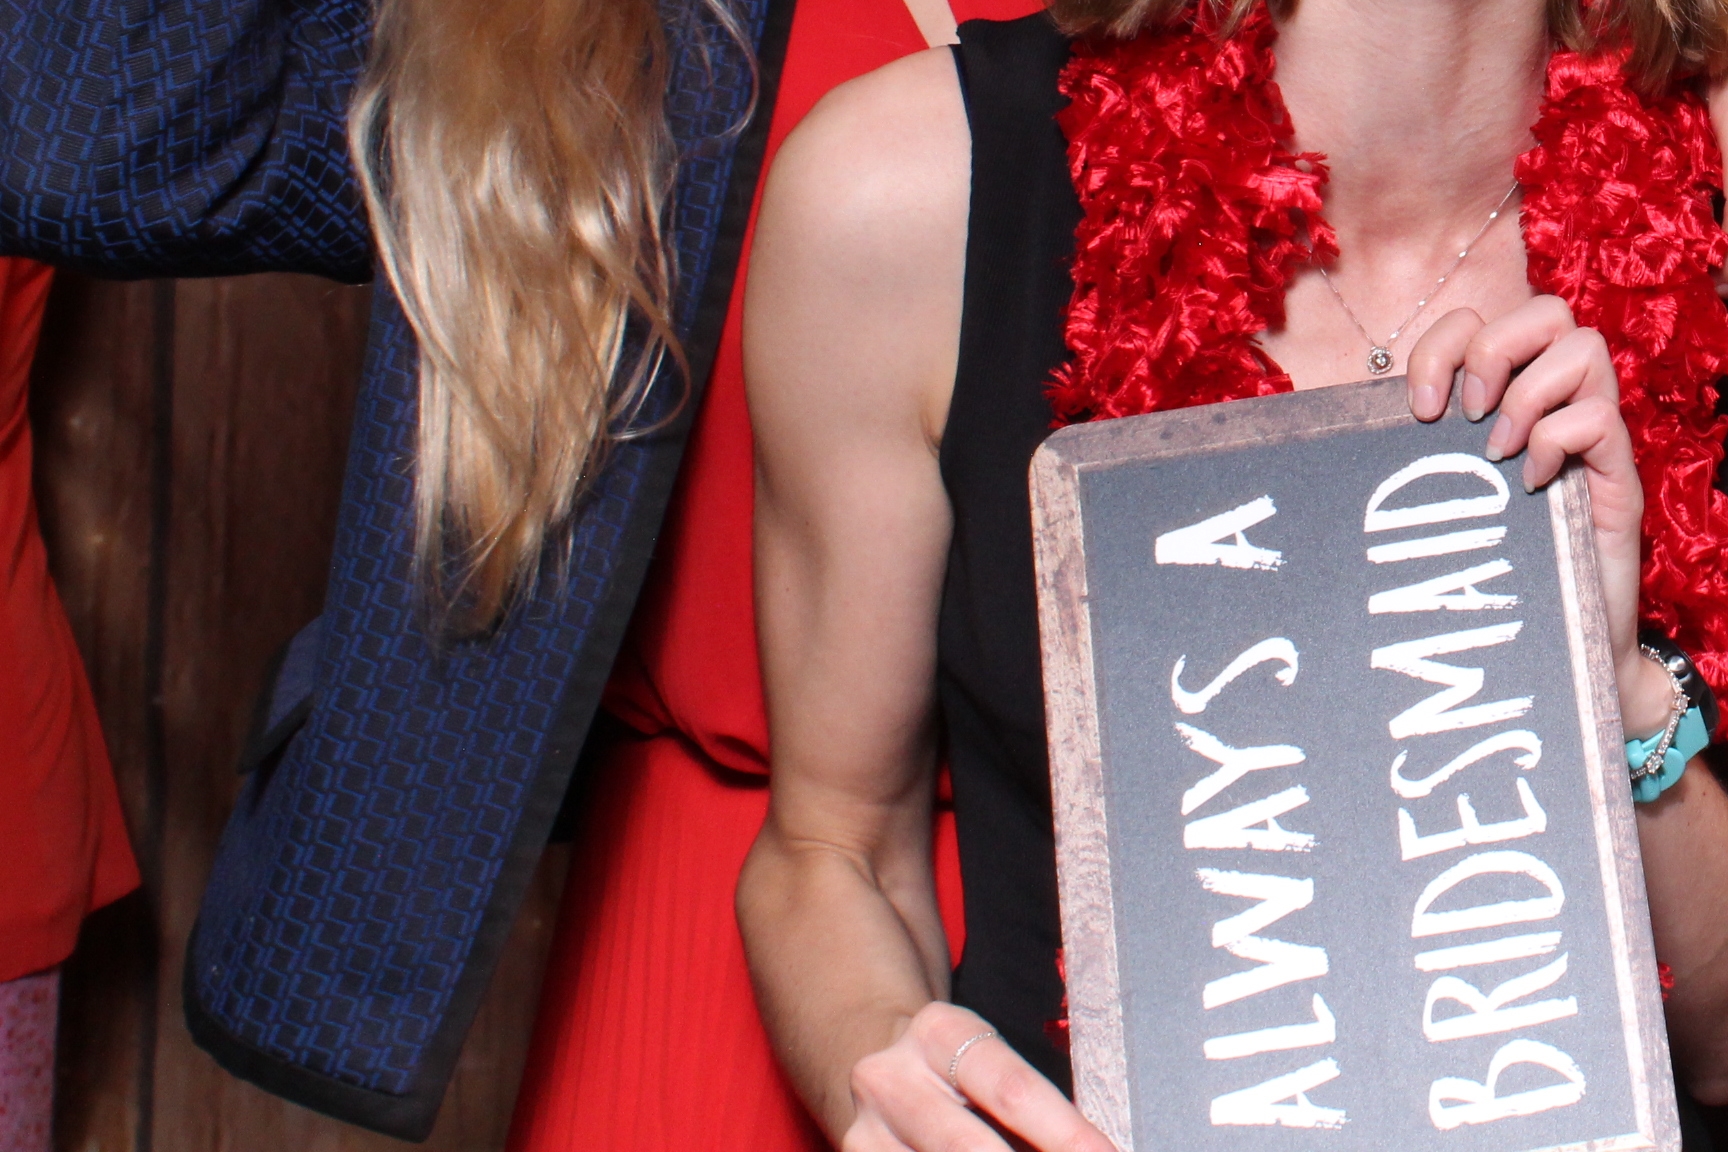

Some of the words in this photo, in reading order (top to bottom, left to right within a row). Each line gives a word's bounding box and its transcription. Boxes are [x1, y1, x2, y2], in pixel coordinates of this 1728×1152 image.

[1154, 494, 1286, 572] A
[1171, 636, 1352, 1130] ALWAYS
[1363, 451, 1587, 1131] BRIDESMAID
